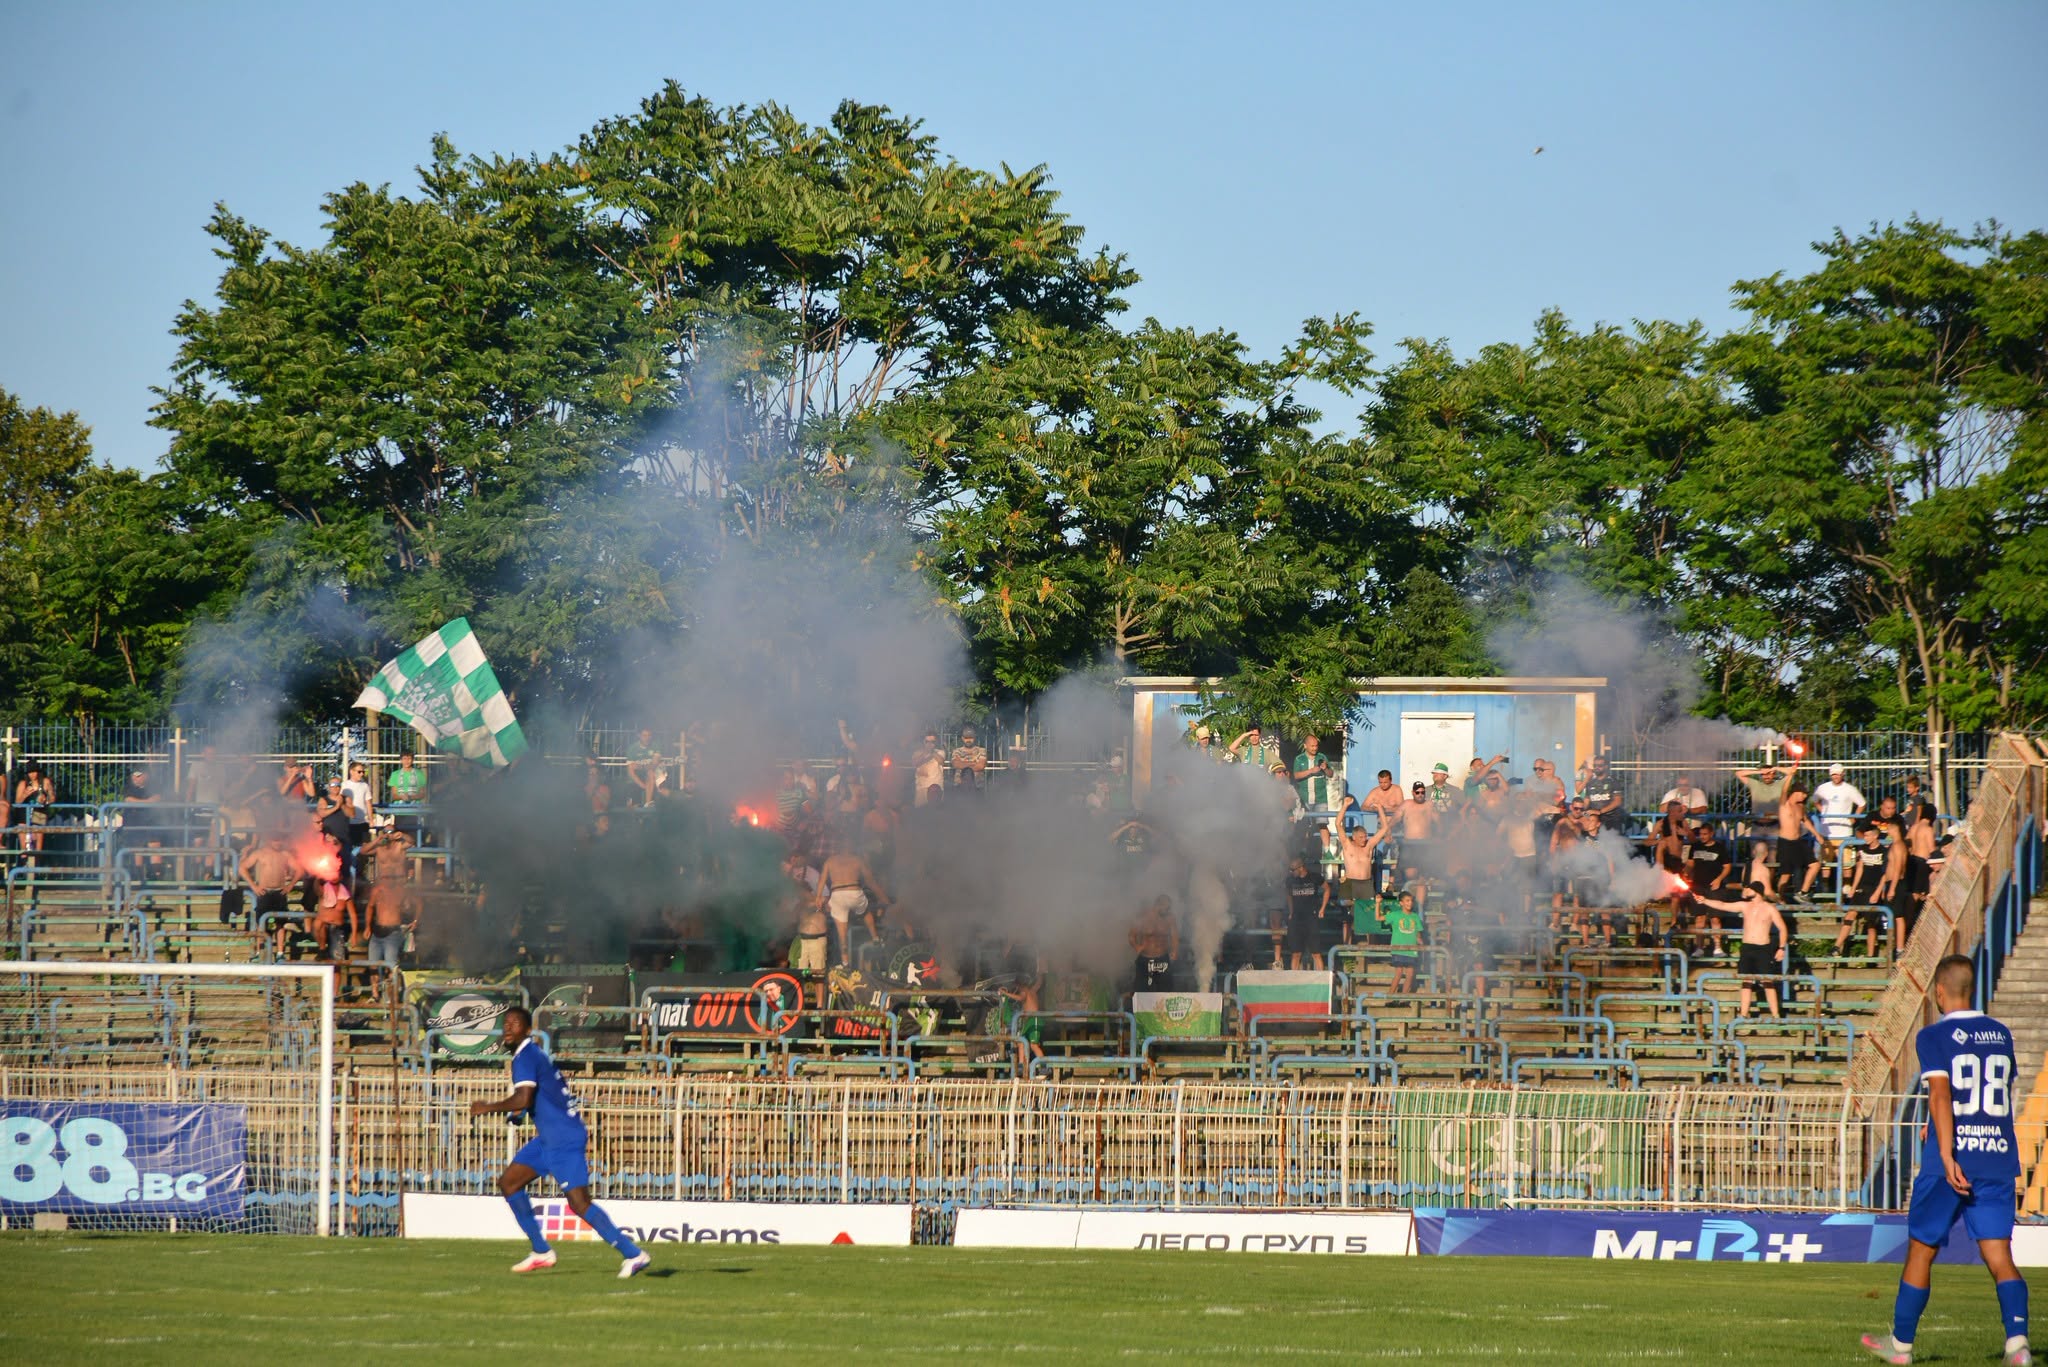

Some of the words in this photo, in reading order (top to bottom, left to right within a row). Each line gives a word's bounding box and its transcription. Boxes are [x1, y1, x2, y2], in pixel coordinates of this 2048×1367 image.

[469, 1003, 510, 1020] Boys
[693, 992, 745, 1027] OUT
[1951, 1053, 2011, 1117] 98
[1956, 1125, 2002, 1137] ОБЩИНА
[1953, 1136, 2009, 1153] УРГАС
[1134, 1233, 1231, 1252] ЛЕГО
[1242, 1234, 1334, 1253] ГРУП
[1345, 1236, 1368, 1254] 5
